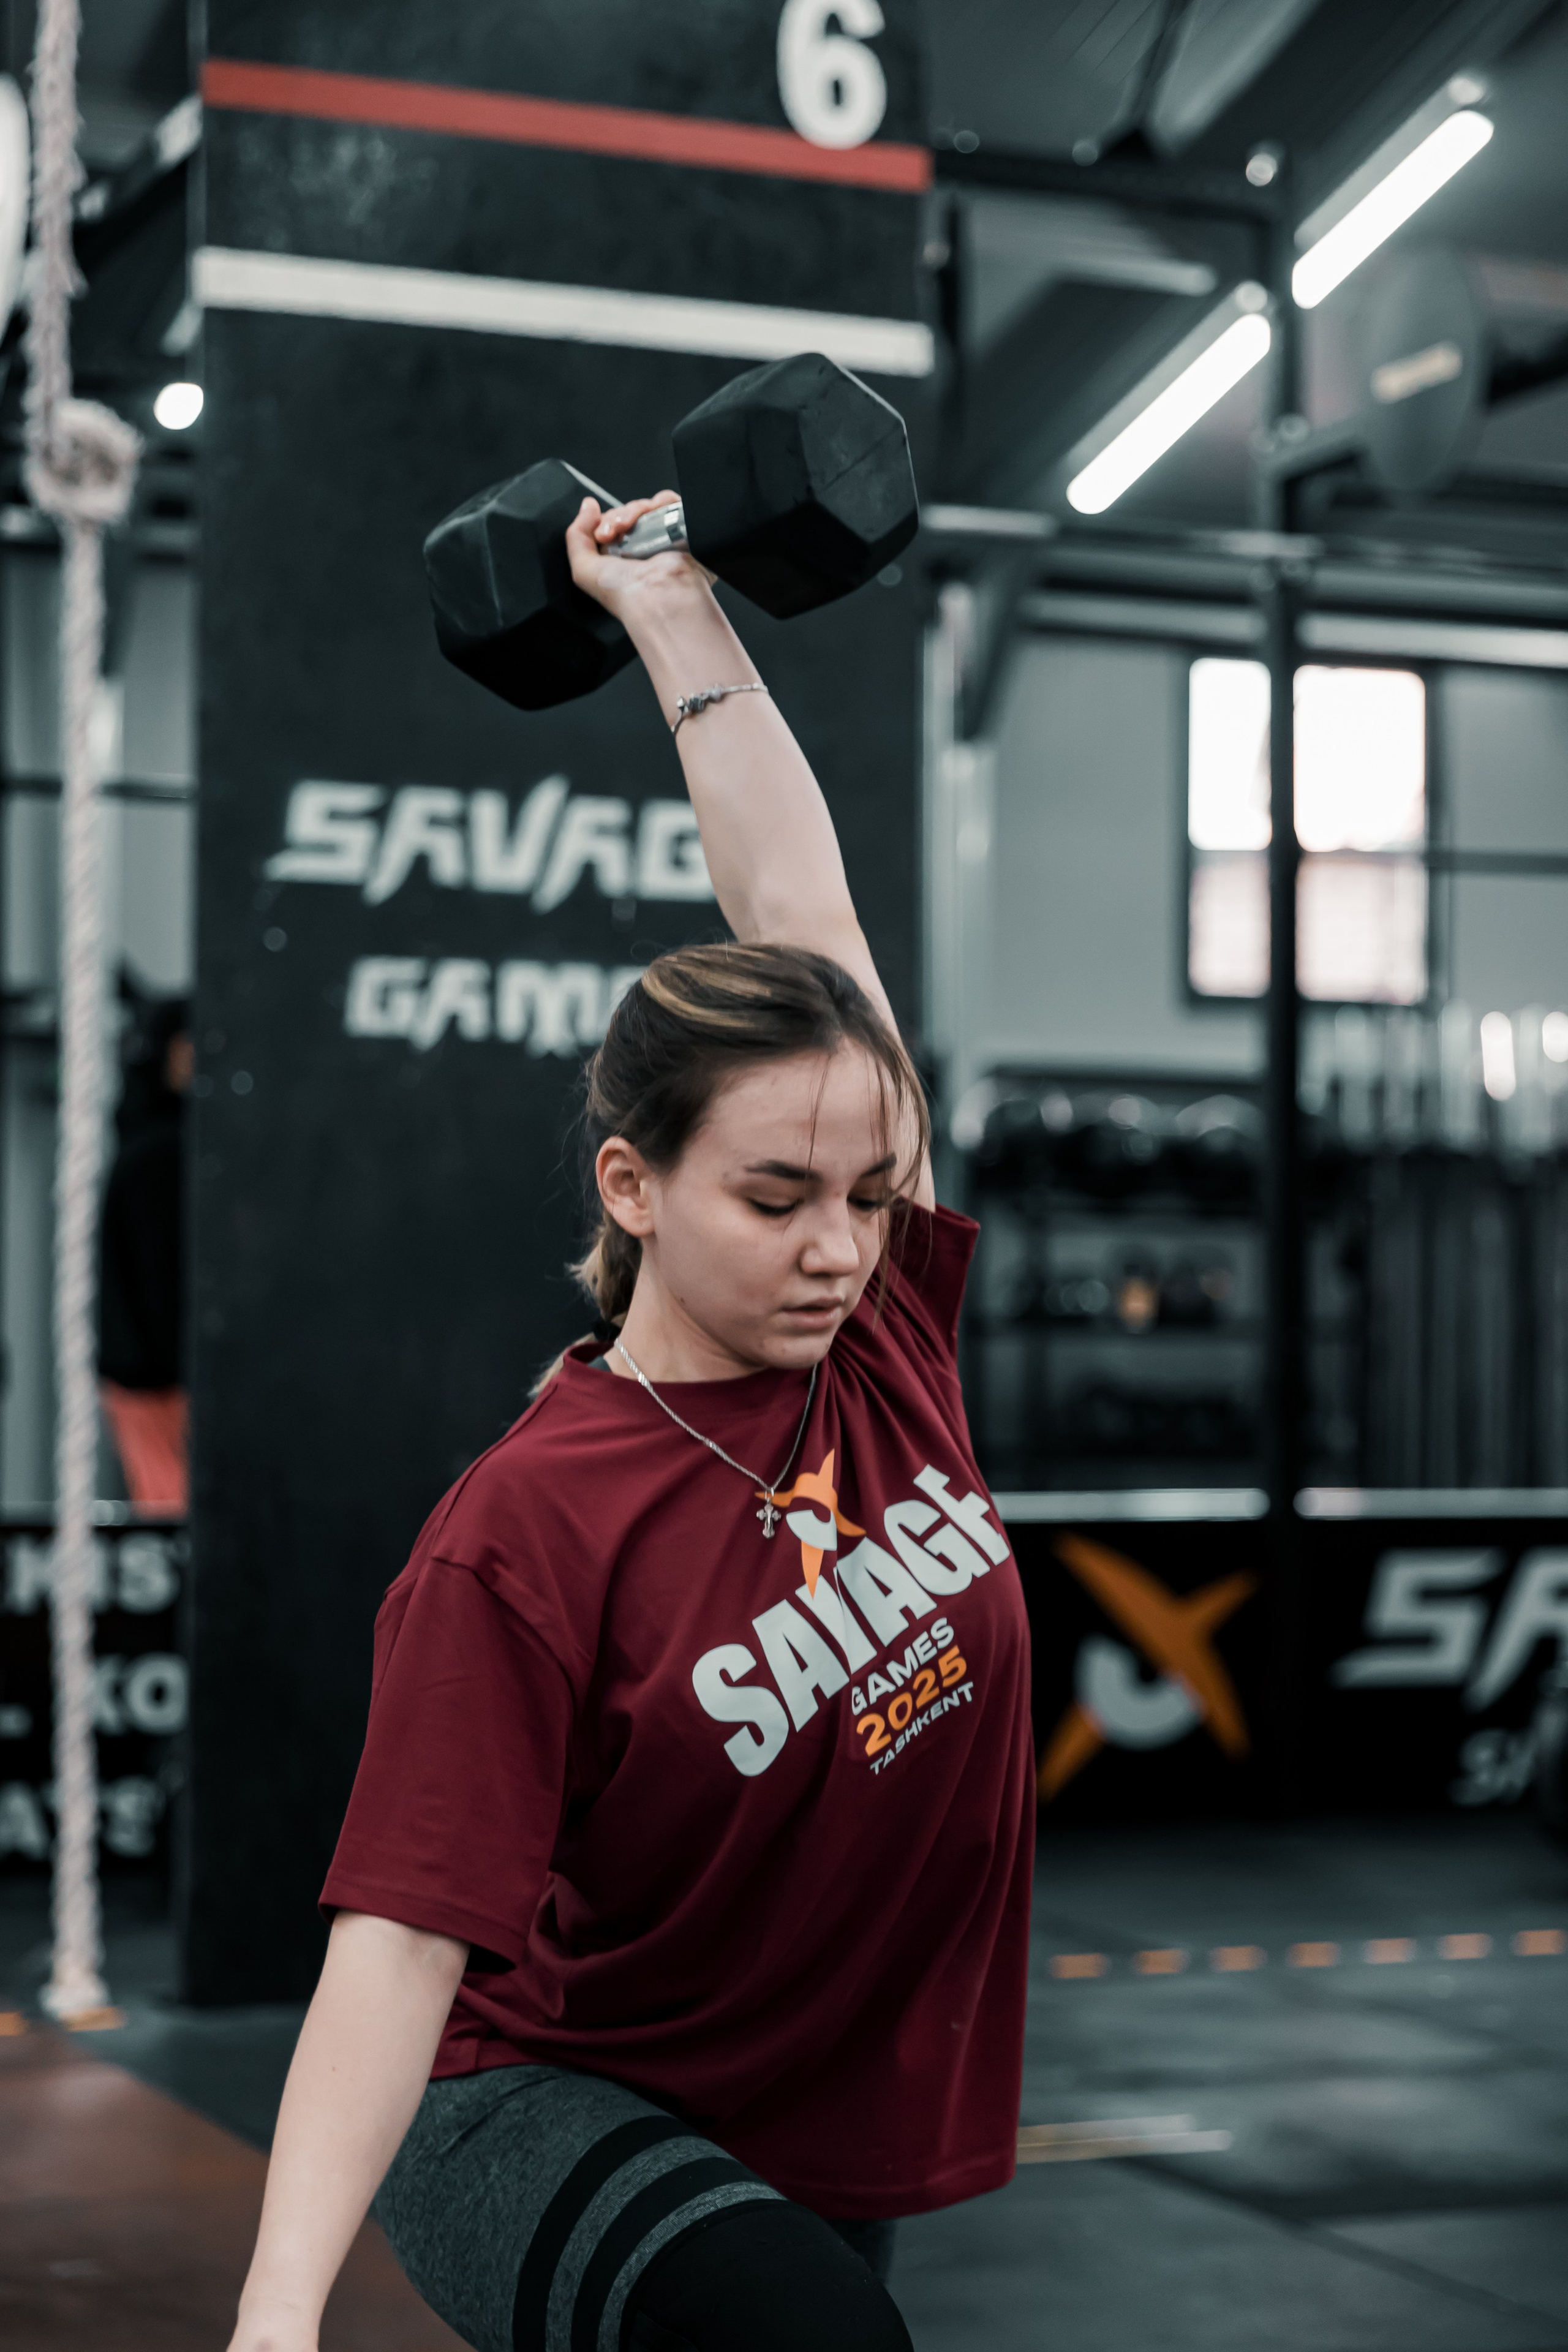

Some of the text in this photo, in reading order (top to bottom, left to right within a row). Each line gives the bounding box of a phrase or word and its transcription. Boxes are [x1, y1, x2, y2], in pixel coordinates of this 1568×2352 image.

[776, 0, 887, 150] 6
[692, 1464, 1010, 1777] SAVAGE
[851, 1617, 954, 1716] GAMES
[856, 1645, 967, 1757] 2025
[870, 1681, 974, 1775] TASHKENT
